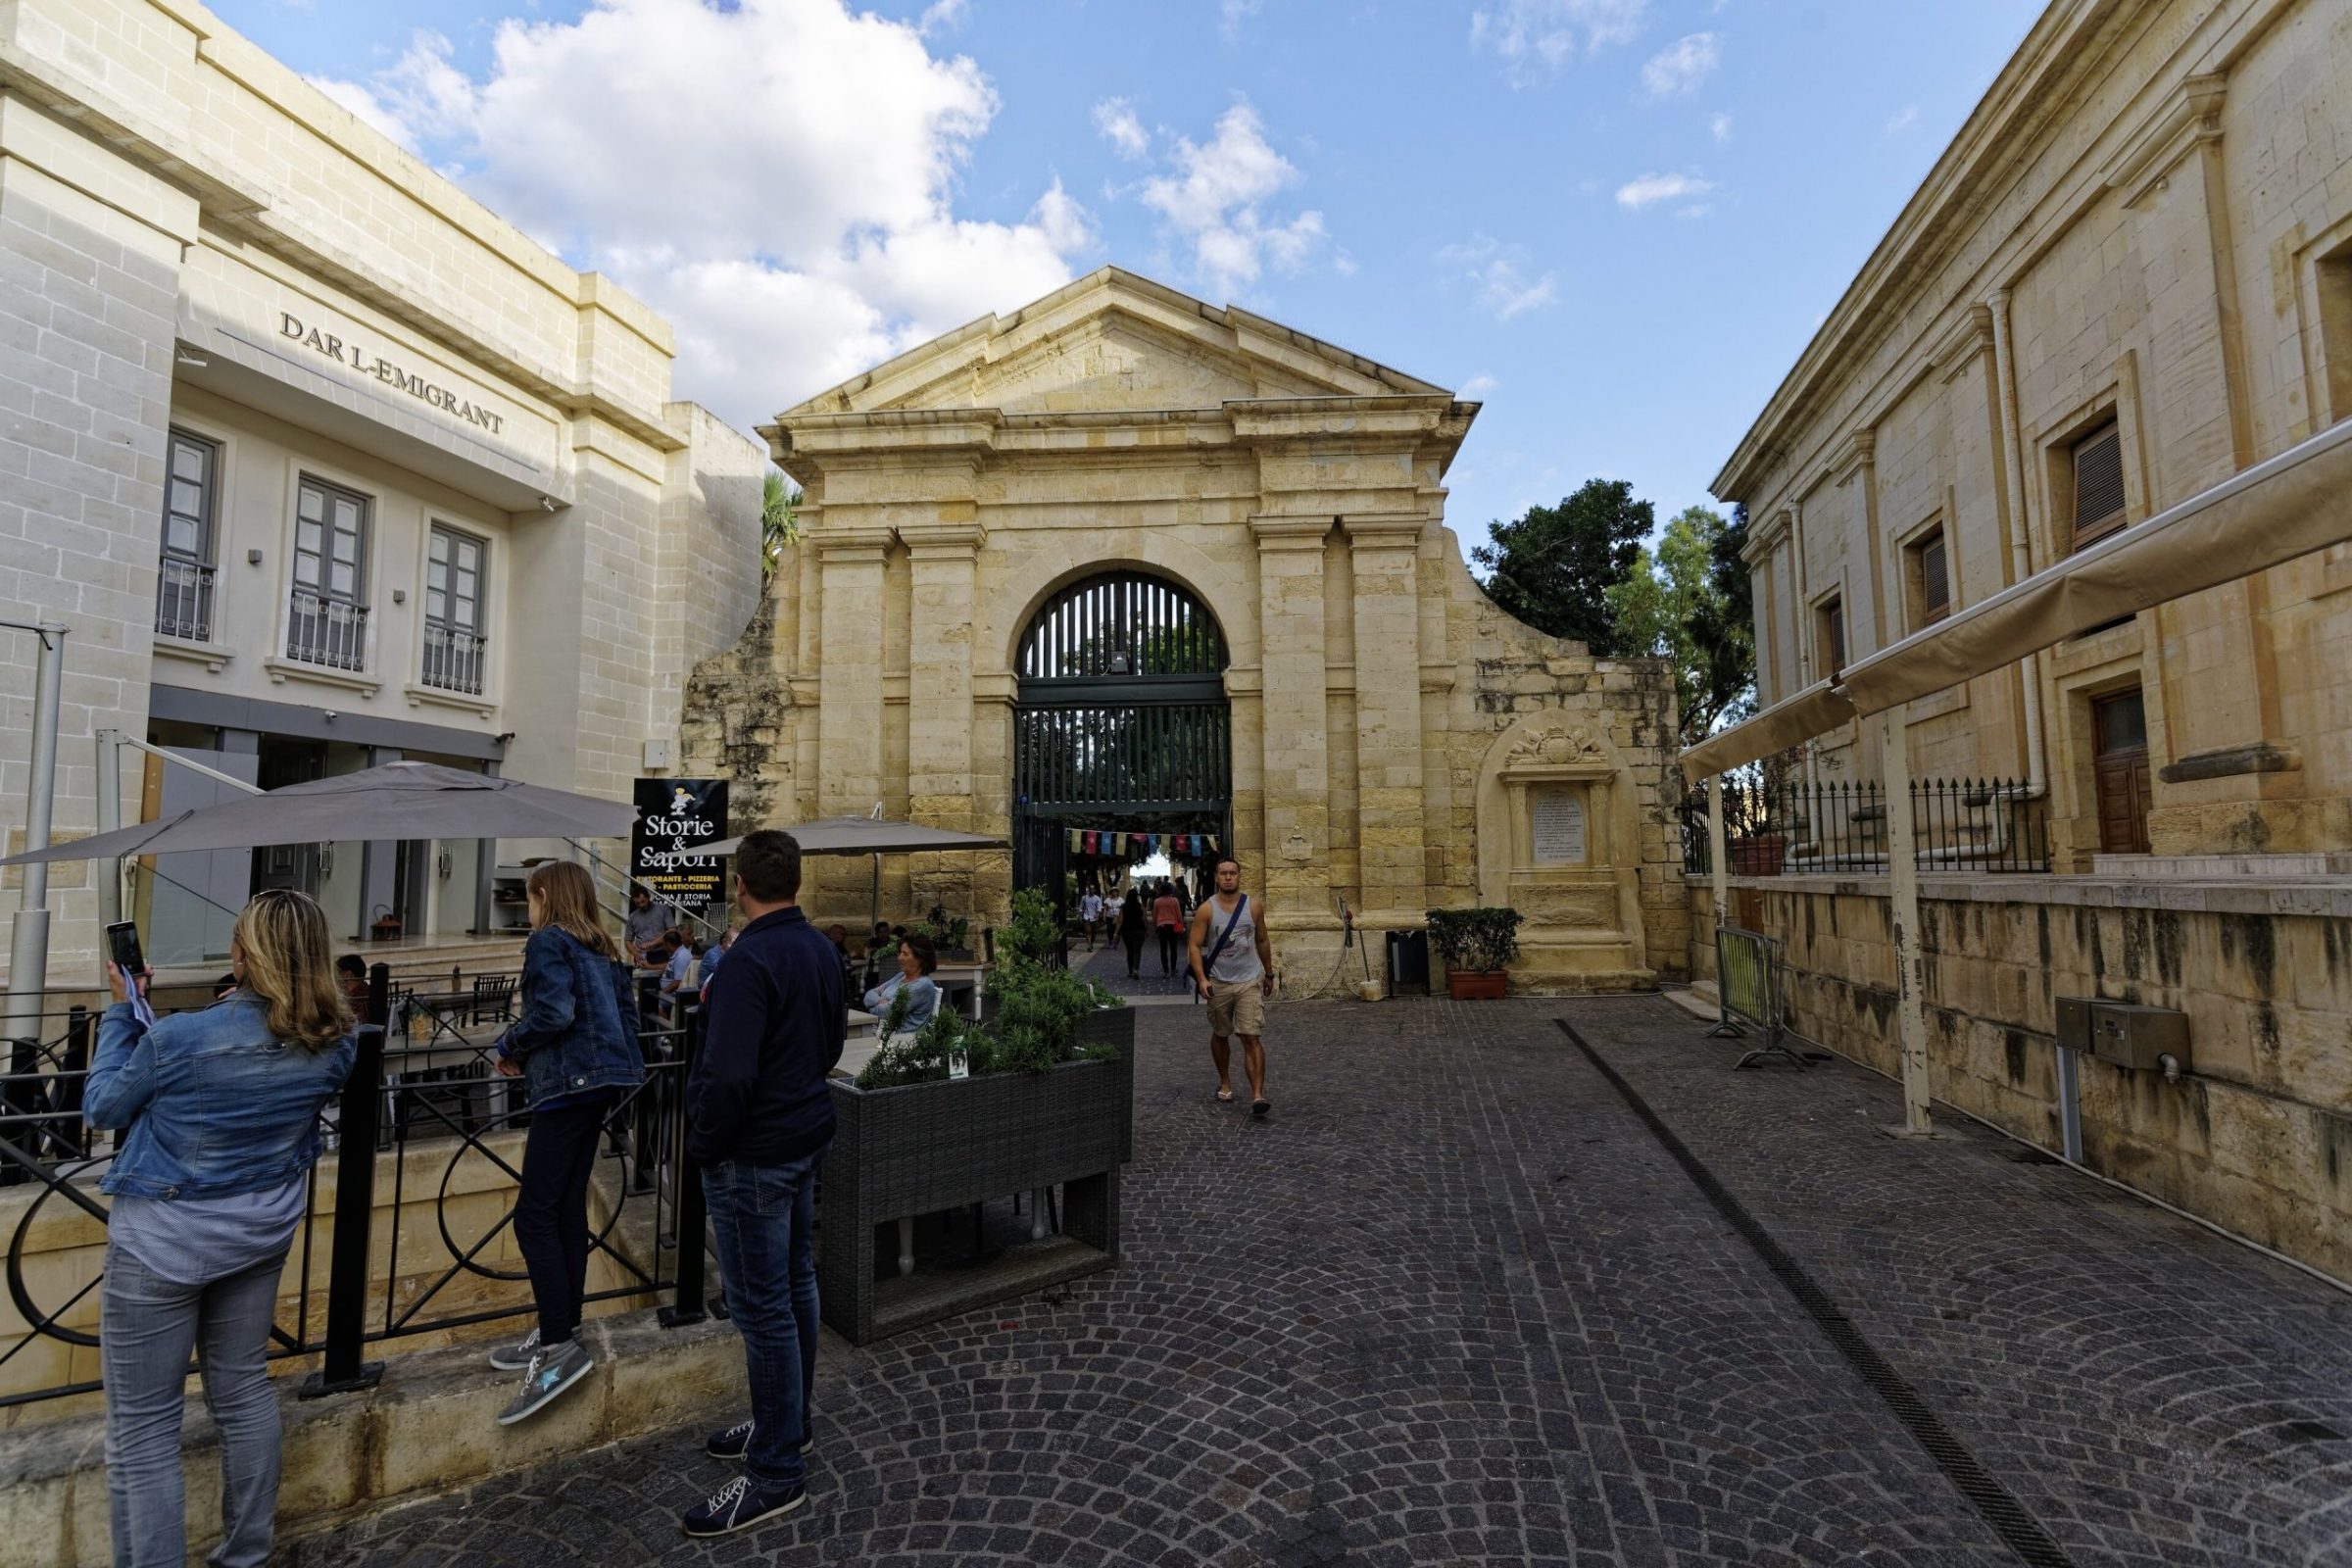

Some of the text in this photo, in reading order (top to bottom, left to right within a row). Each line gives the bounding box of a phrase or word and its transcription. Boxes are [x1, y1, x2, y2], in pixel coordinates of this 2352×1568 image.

[280, 311, 504, 435] DAR L-EMIGRANT
[645, 814, 713, 836] Storie
[671, 836, 686, 851] &
